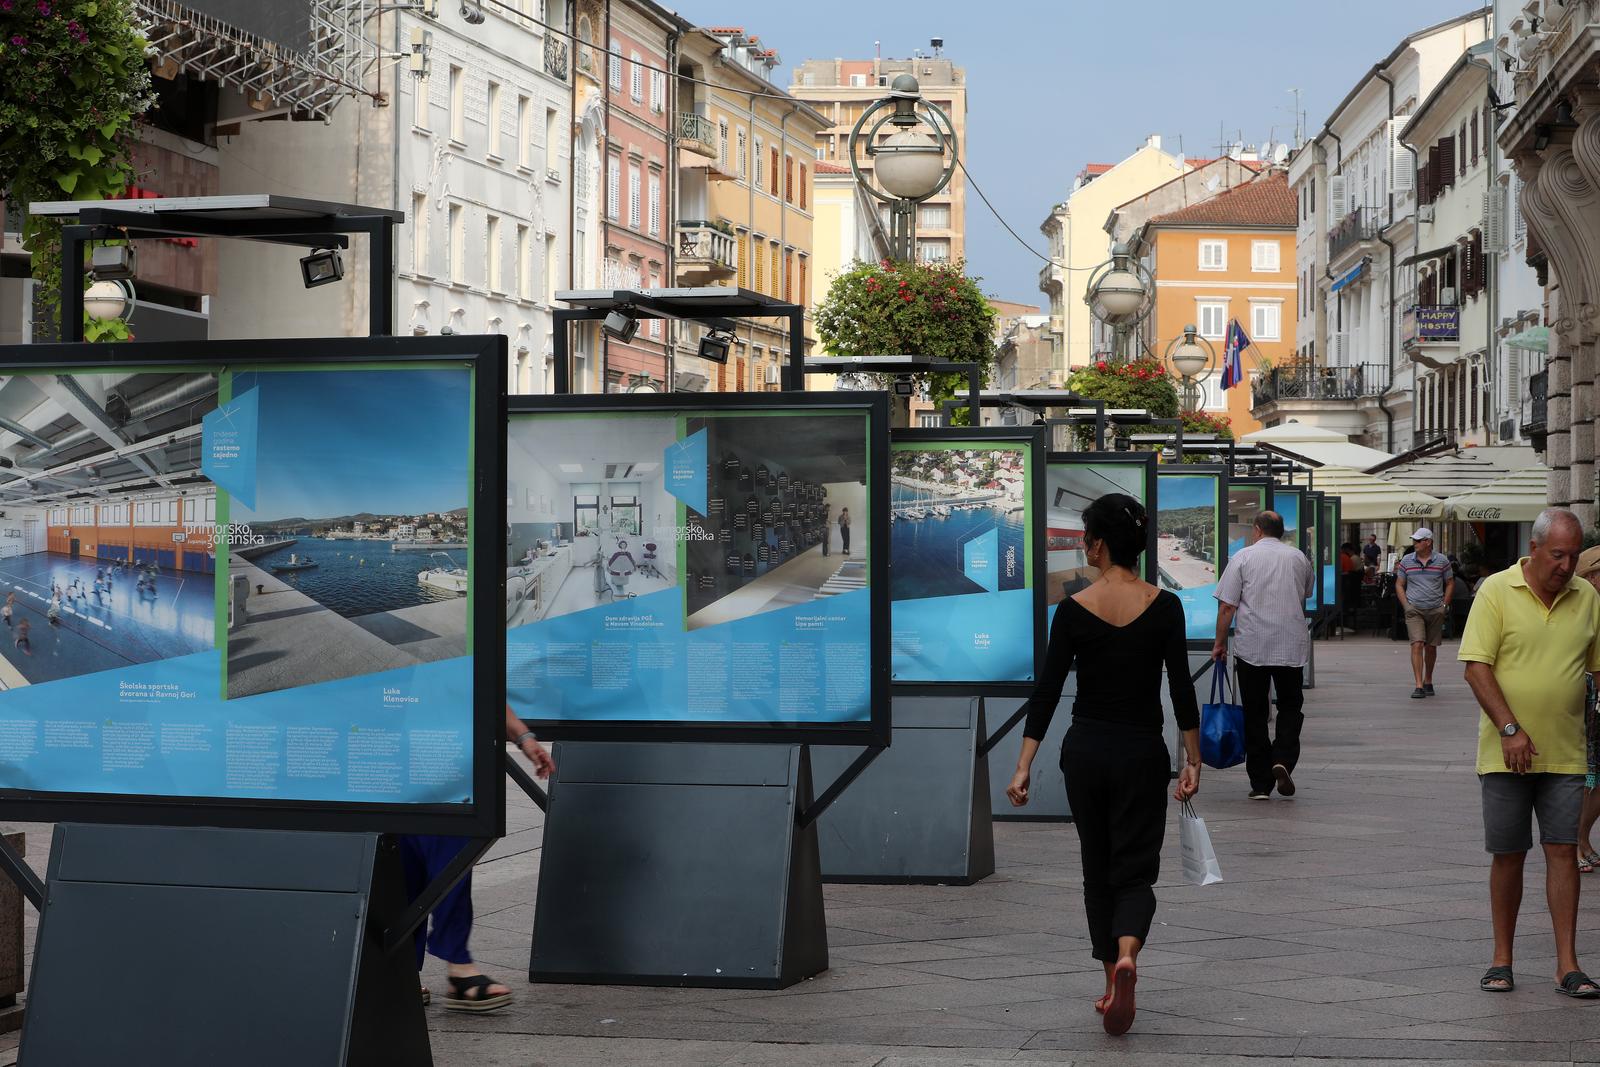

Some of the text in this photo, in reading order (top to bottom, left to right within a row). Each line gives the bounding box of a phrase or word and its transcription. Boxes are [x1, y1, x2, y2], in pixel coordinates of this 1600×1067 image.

[213, 452, 238, 460] zajedno
[186, 521, 250, 538] primorsko
[207, 529, 264, 548] goranska
[120, 680, 147, 689] Školska
[156, 691, 179, 699] Ravnoj
[384, 695, 419, 703] Klenovica
